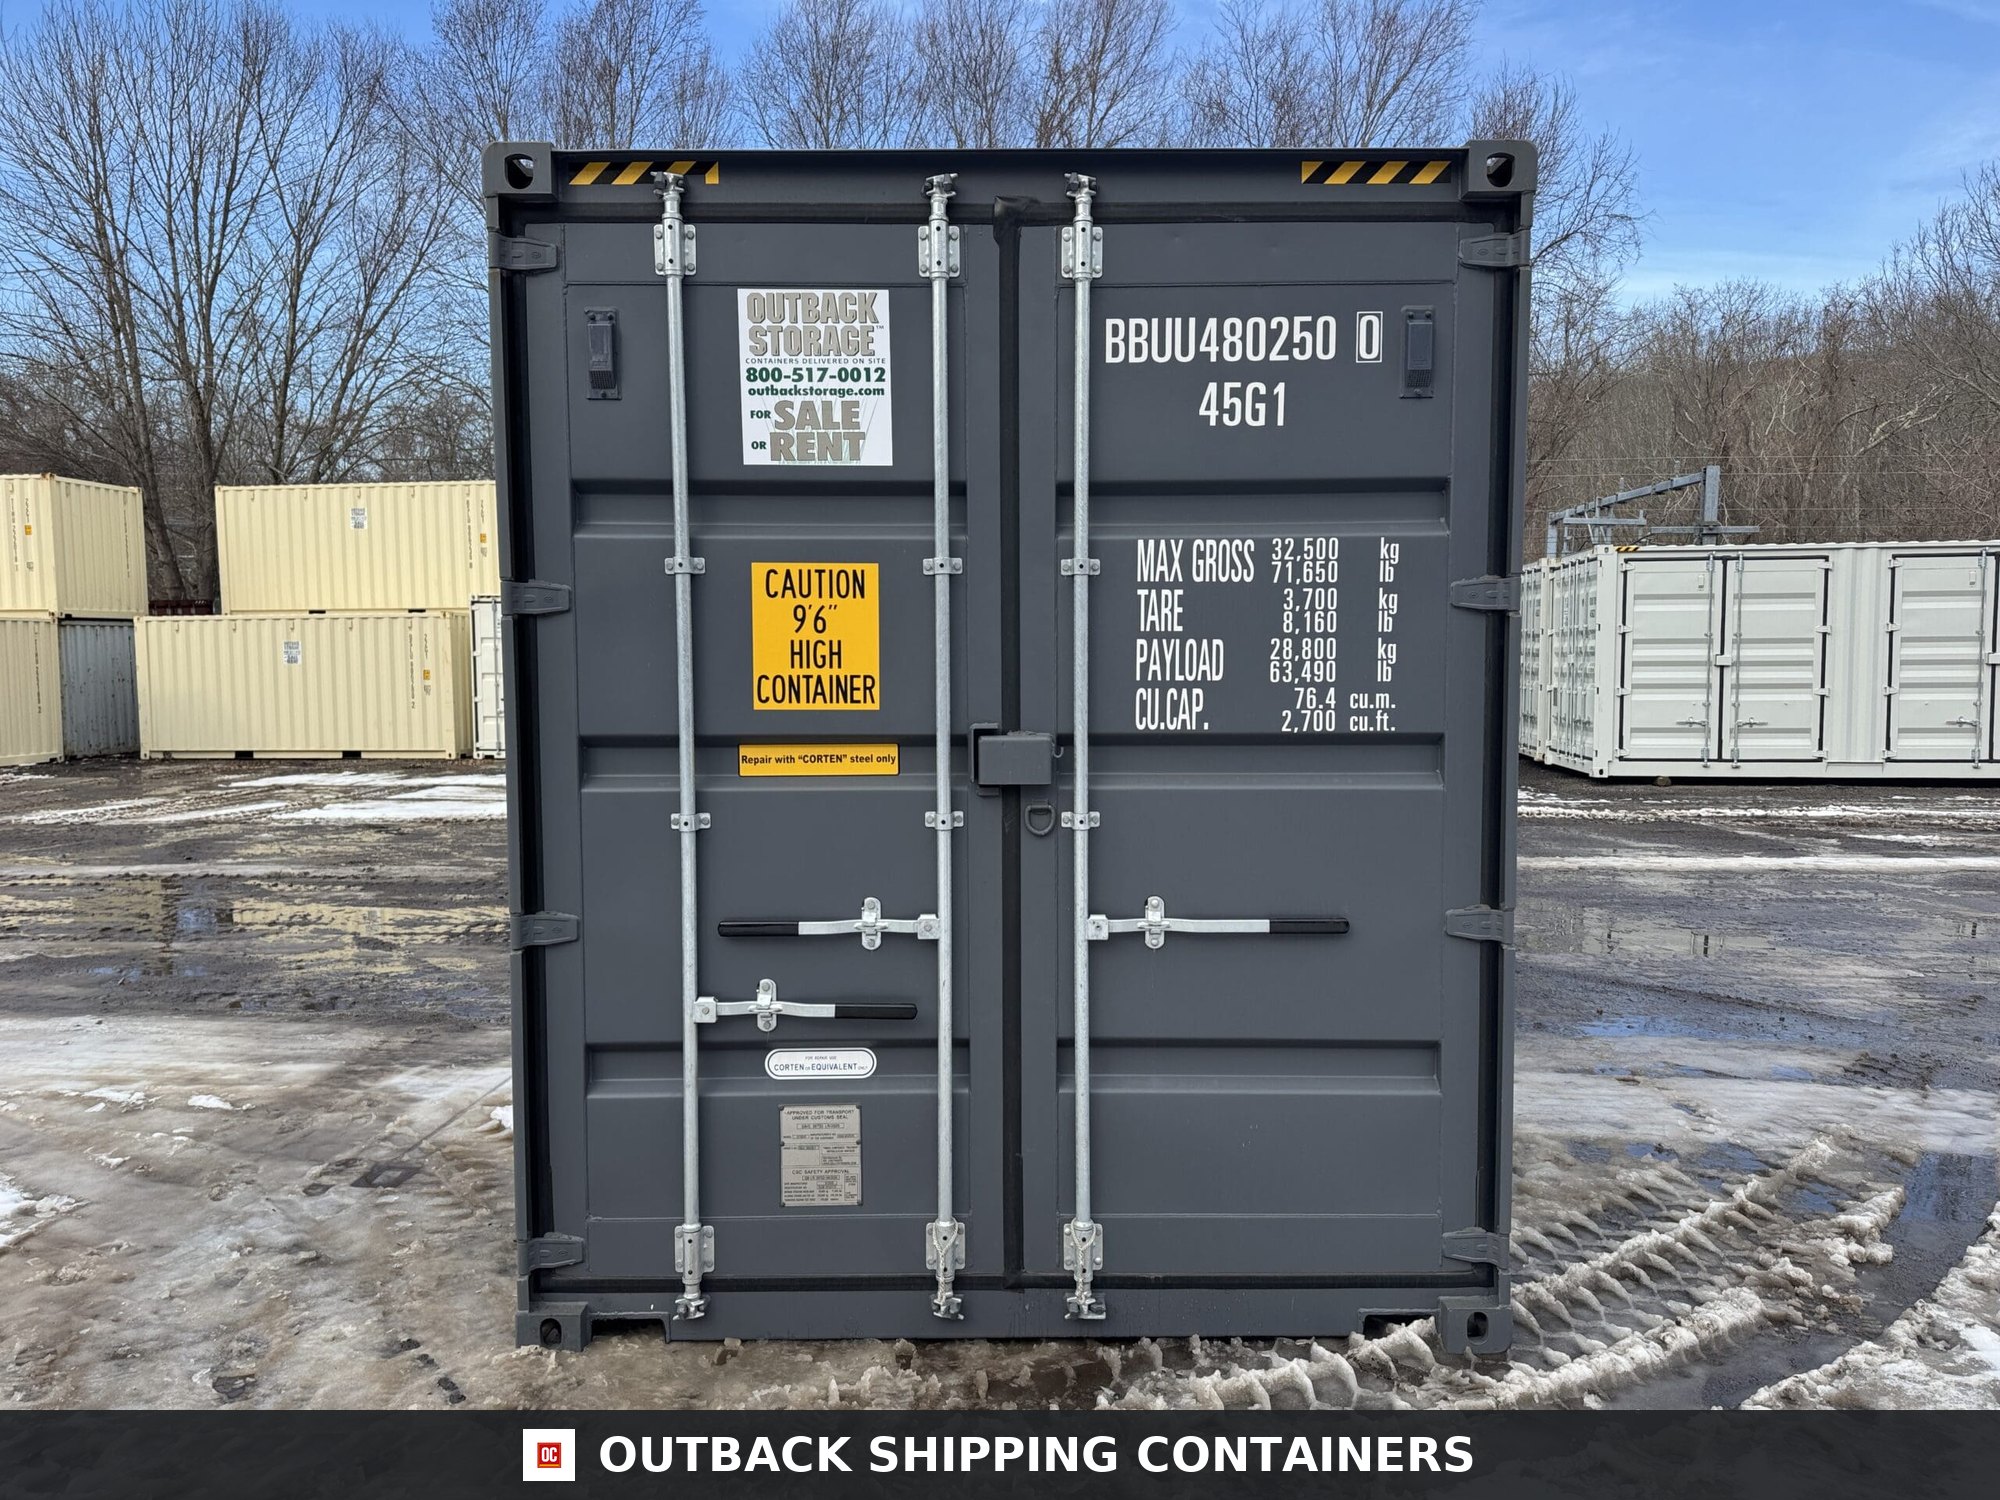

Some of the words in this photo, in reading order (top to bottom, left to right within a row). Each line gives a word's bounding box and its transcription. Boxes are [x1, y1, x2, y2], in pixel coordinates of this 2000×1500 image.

[746, 292, 879, 324] OUTBACK
[748, 325, 876, 357] STORAGE
[1106, 316, 1336, 363] BBUU480250
[746, 367, 885, 382] 800-517-0012
[747, 384, 886, 398] outbackstorage.com
[1199, 382, 1285, 426] 45G1
[750, 410, 771, 419] FOR
[774, 400, 861, 431] SALE
[751, 441, 767, 450] OR
[769, 432, 866, 462] RENT
[1137, 539, 1183, 582] MAX
[1193, 539, 1254, 582] GROSS
[1272, 538, 1338, 562] 32,500
[1380, 537, 1399, 564] kg
[1272, 560, 1337, 584] 71,650
[1380, 560, 1394, 582] lb
[766, 569, 864, 598] CAUTION
[1137, 589, 1183, 631] TARE
[1284, 588, 1337, 612] 3,700
[1379, 588, 1397, 614] kg
[1283, 611, 1336, 634] 8,160
[1379, 611, 1393, 632] lb
[791, 640, 841, 668] HIGH
[1136, 639, 1223, 681] PAYLOAD
[1270, 638, 1336, 662] 28,800
[1378, 638, 1396, 665] kg
[1270, 660, 1335, 684] 63,490
[1378, 661, 1392, 681] lb
[757, 675, 875, 703] CONTAINER
[1136, 688, 1208, 730] CU.CAP.
[1295, 687, 1336, 709] 76.4
[1350, 693, 1395, 708] cu.m.
[1282, 710, 1335, 733] 2,700
[1350, 710, 1395, 731] cu.ft.
[741, 754, 772, 766] Repair
[775, 755, 795, 764] with
[850, 754, 873, 764] steel
[876, 754, 896, 764] only
